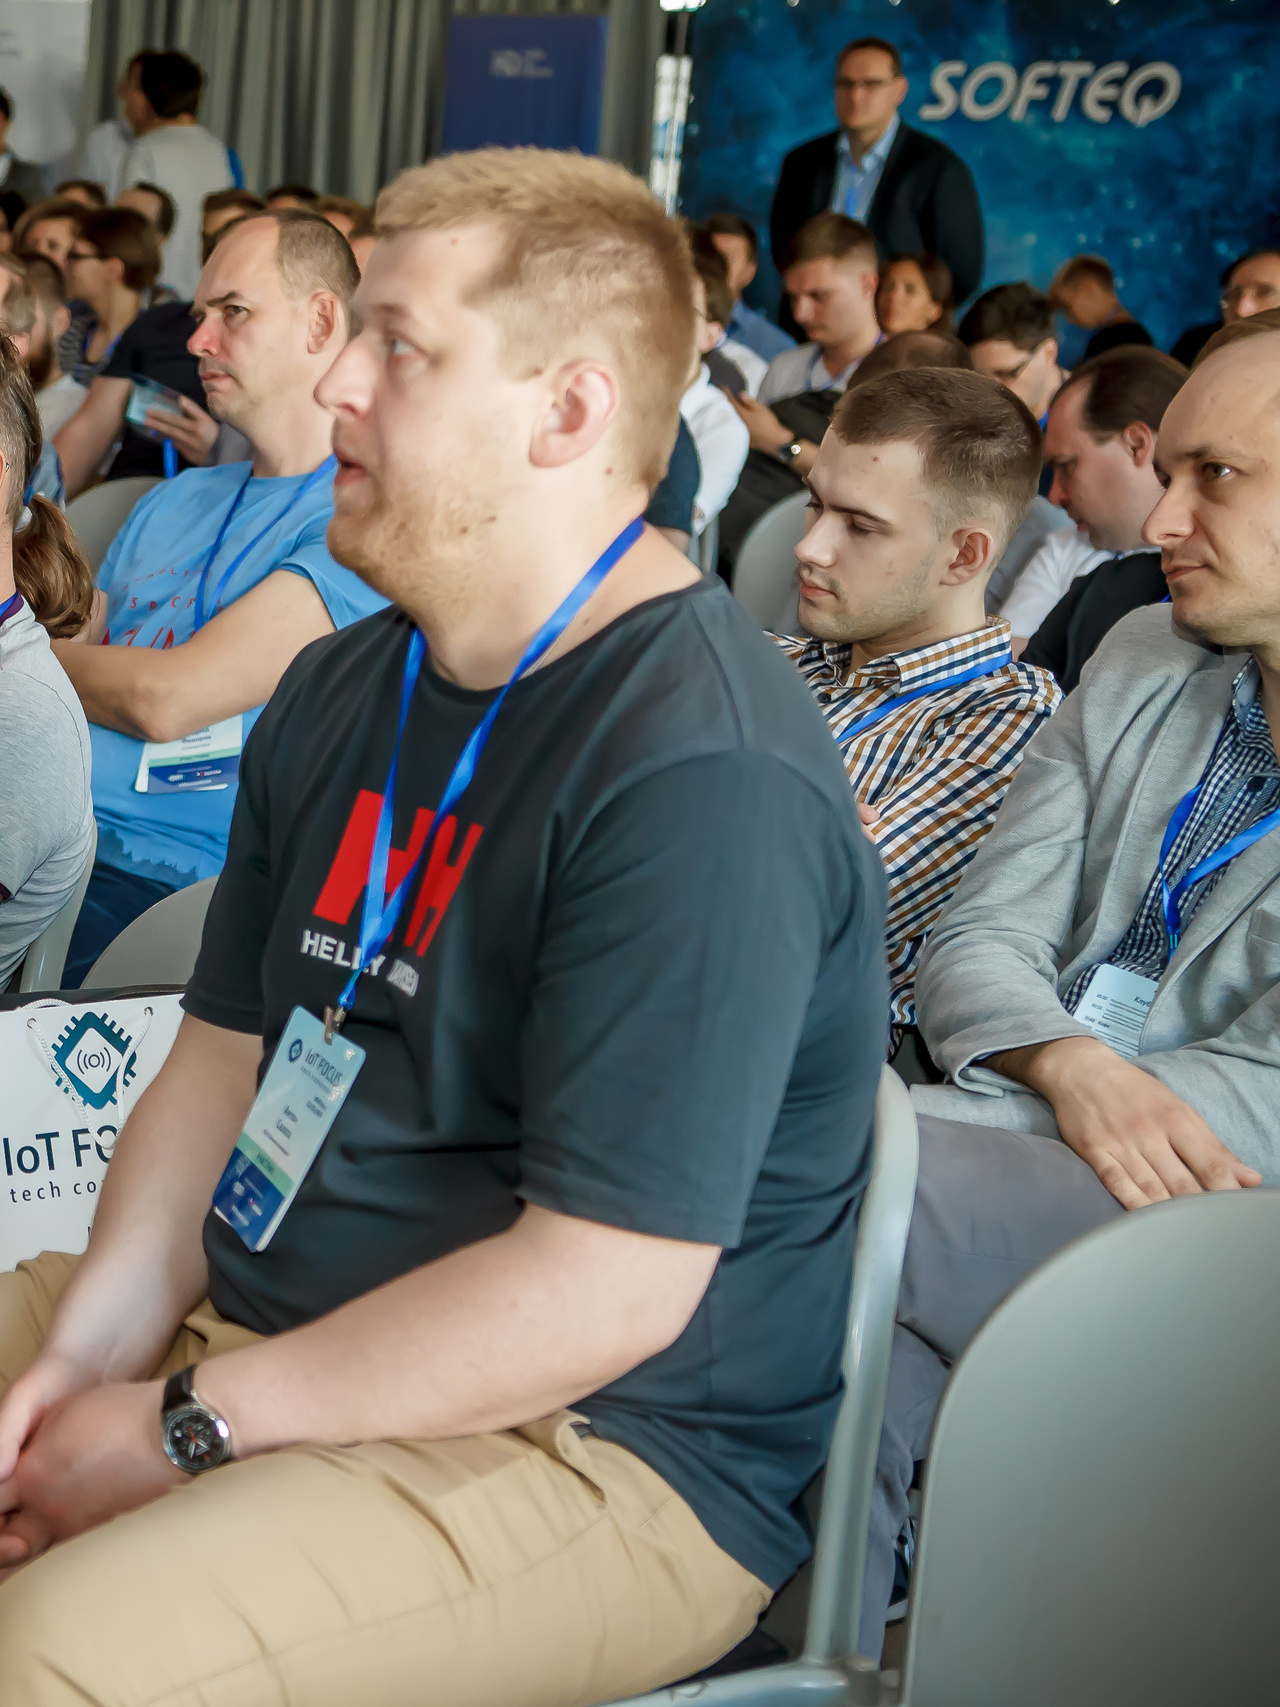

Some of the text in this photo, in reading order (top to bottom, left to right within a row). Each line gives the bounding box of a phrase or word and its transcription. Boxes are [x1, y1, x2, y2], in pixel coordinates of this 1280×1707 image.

[919, 60, 1182, 128] SOFTEQ
[317, 1057, 343, 1087] FOCUS
[3, 1132, 60, 1176] IoT
[10, 1180, 104, 1203] tech co
